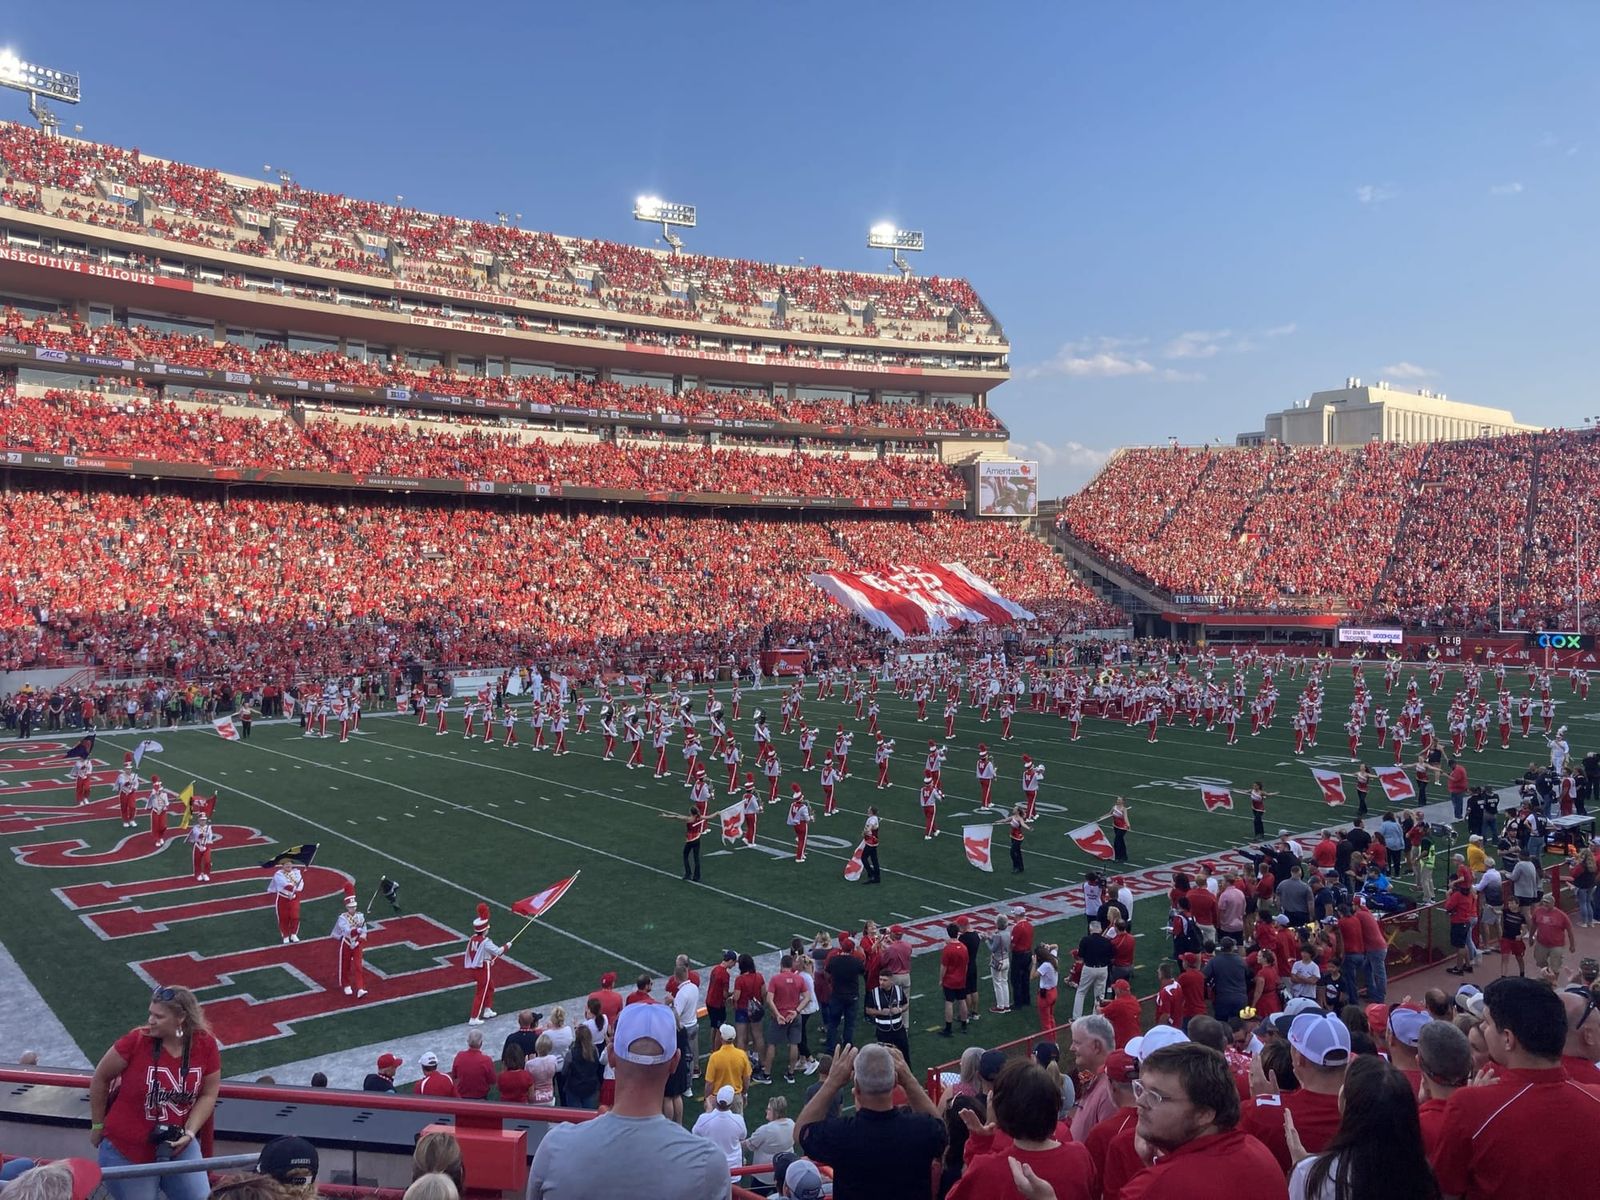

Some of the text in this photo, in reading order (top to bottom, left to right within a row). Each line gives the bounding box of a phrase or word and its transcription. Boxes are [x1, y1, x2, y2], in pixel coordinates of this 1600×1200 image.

[88, 264, 155, 285] SELLOUTS
[393, 280, 517, 305] NATIONAL CHAMPIONSHIPS
[86, 357, 122, 367] PITTSBURGH
[665, 347, 699, 358] NATION
[704, 352, 743, 363] LEADING
[769, 358, 816, 368] ACADEMIC
[819, 362, 835, 370] ALL
[840, 363, 890, 373] AMERICANS
[272, 379, 297, 388] WYOMING
[986, 466, 1020, 475] Ameritas
[1174, 595, 1236, 604] THE BONEYD
[1539, 635, 1581, 649] COX
[145, 1066, 202, 1121] N
